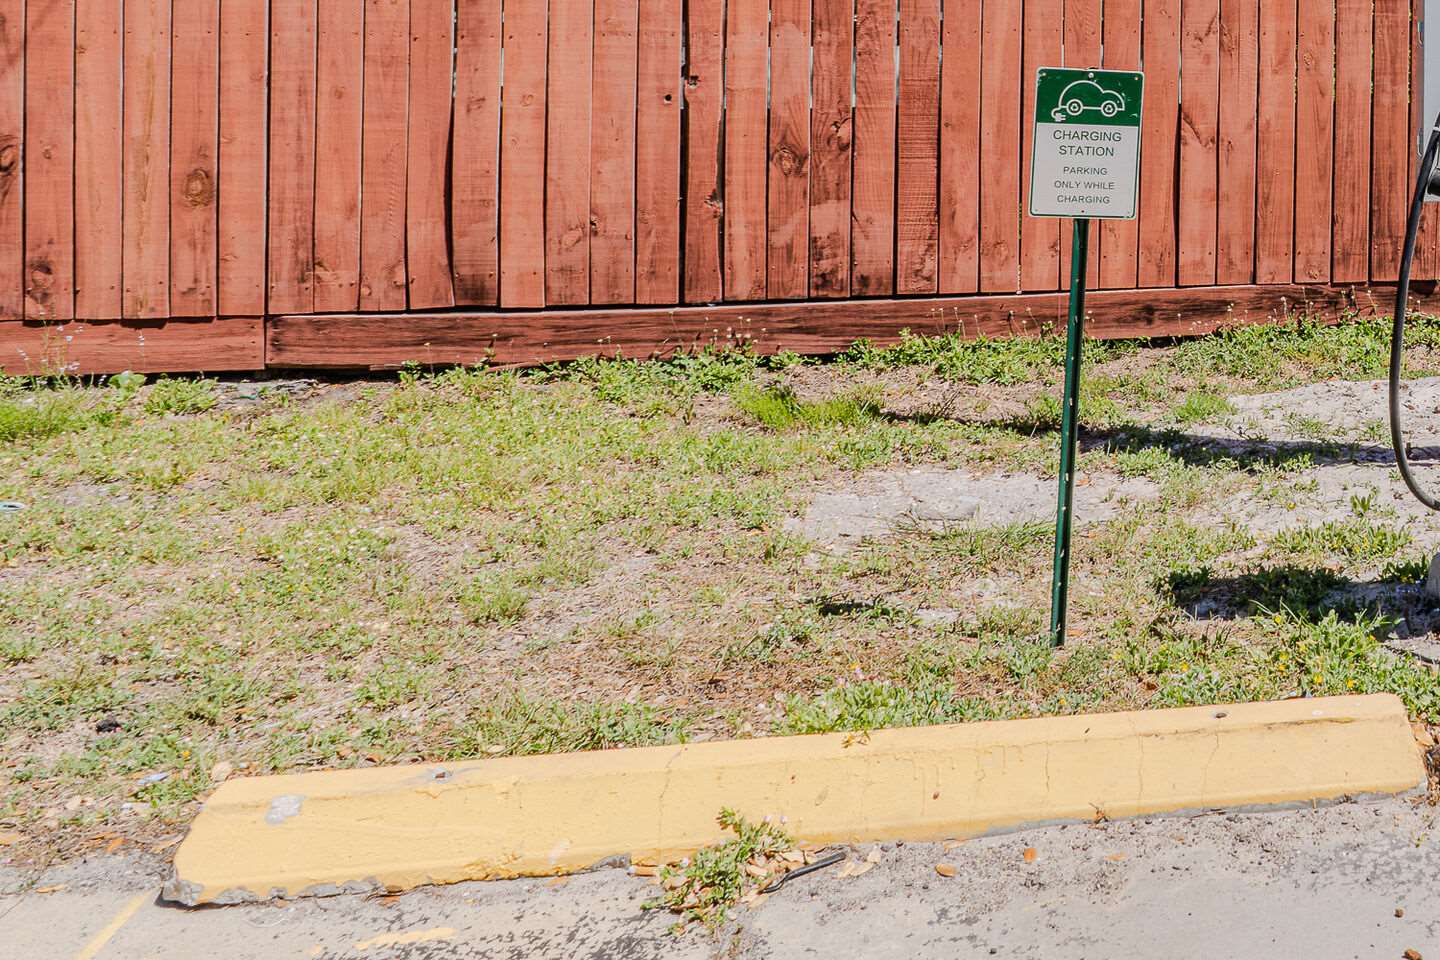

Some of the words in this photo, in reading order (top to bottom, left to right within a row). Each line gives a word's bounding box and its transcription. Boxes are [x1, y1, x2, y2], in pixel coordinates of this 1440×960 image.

[1052, 129, 1122, 142] CHARGING
[1058, 145, 1115, 157] STATION
[1063, 166, 1108, 176] PARKING
[1054, 180, 1081, 189] ONLY
[1083, 181, 1115, 190] WHILE
[1056, 194, 1111, 205] CHARGING
